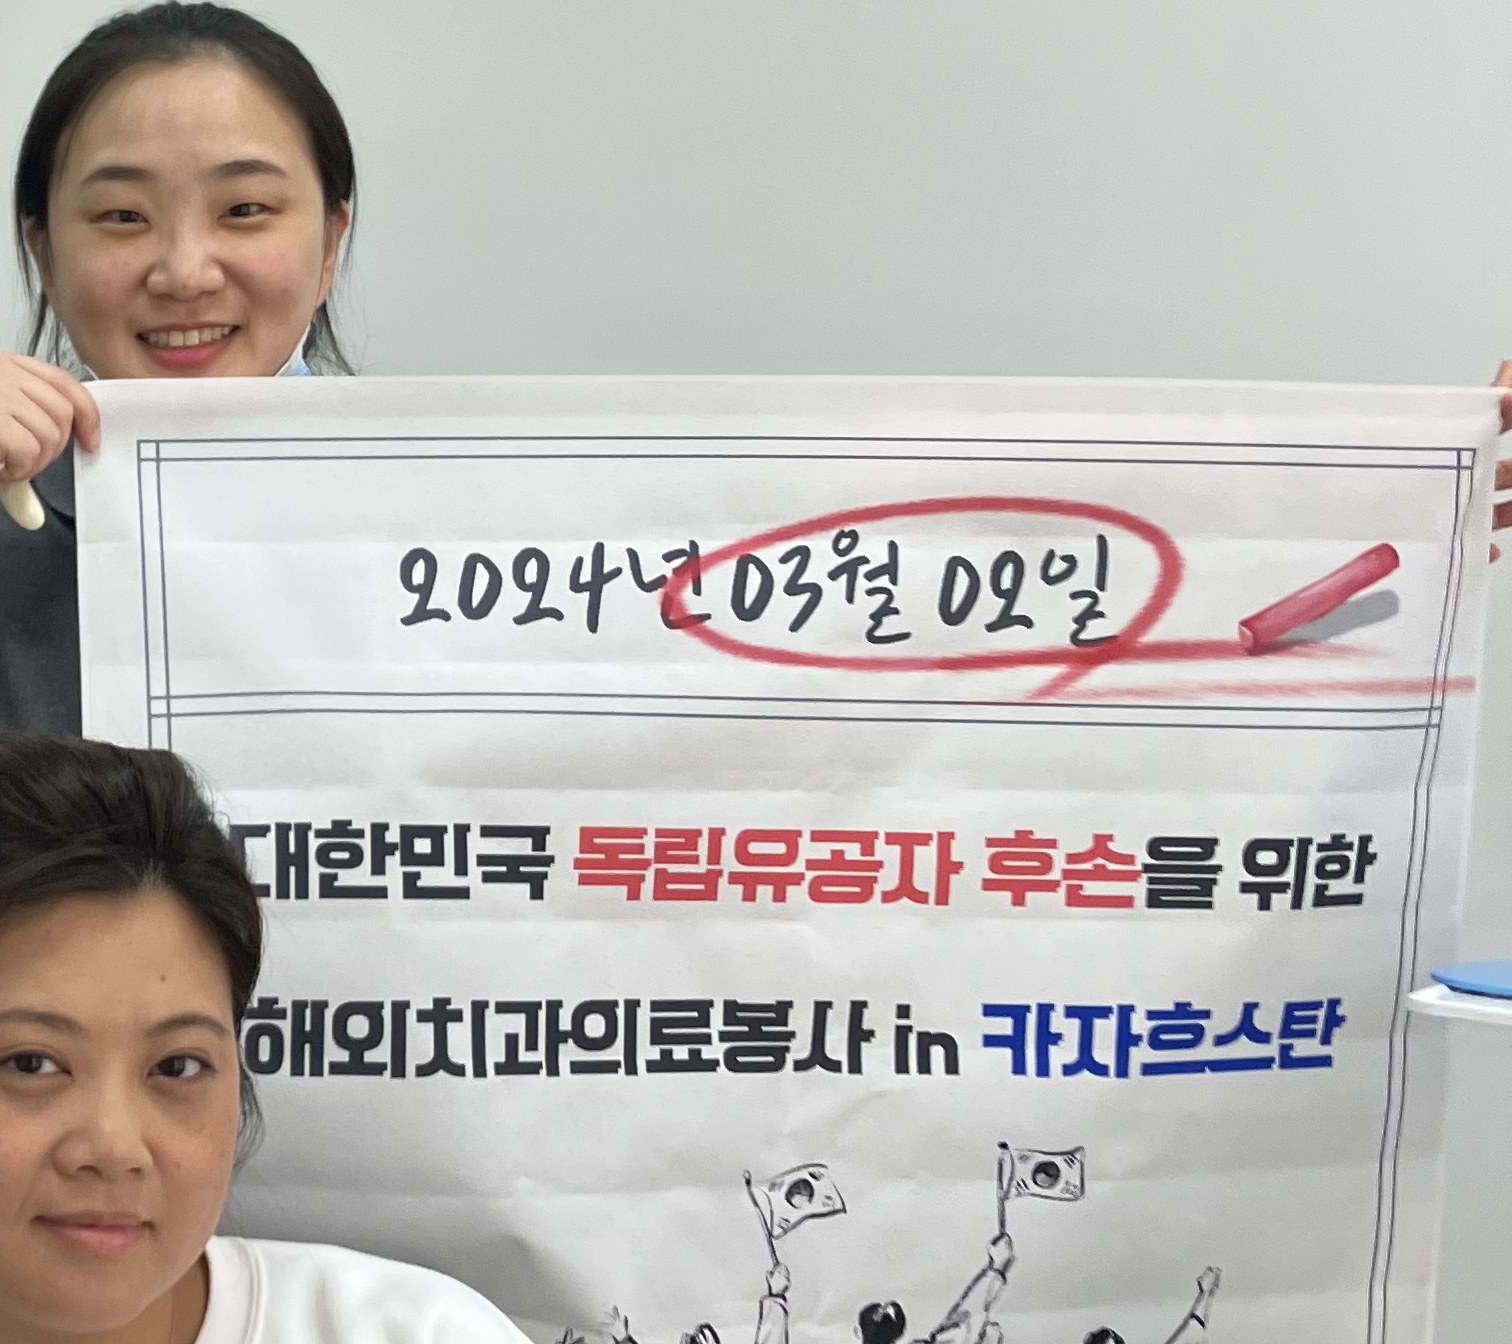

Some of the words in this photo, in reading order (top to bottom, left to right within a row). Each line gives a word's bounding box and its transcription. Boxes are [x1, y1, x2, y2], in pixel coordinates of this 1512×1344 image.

[398, 539, 710, 633] 2024년
[730, 528, 911, 644] 03월
[938, 533, 1120, 647] 02일
[229, 819, 555, 901] 대한민국
[573, 826, 964, 907] 독립유공자
[980, 829, 1223, 910] 후손을
[1238, 833, 1378, 911] 위한
[243, 996, 877, 1079] 해외치과의료봉사
[894, 1003, 960, 1076] in
[981, 997, 1347, 1079] 카자흐스탄
